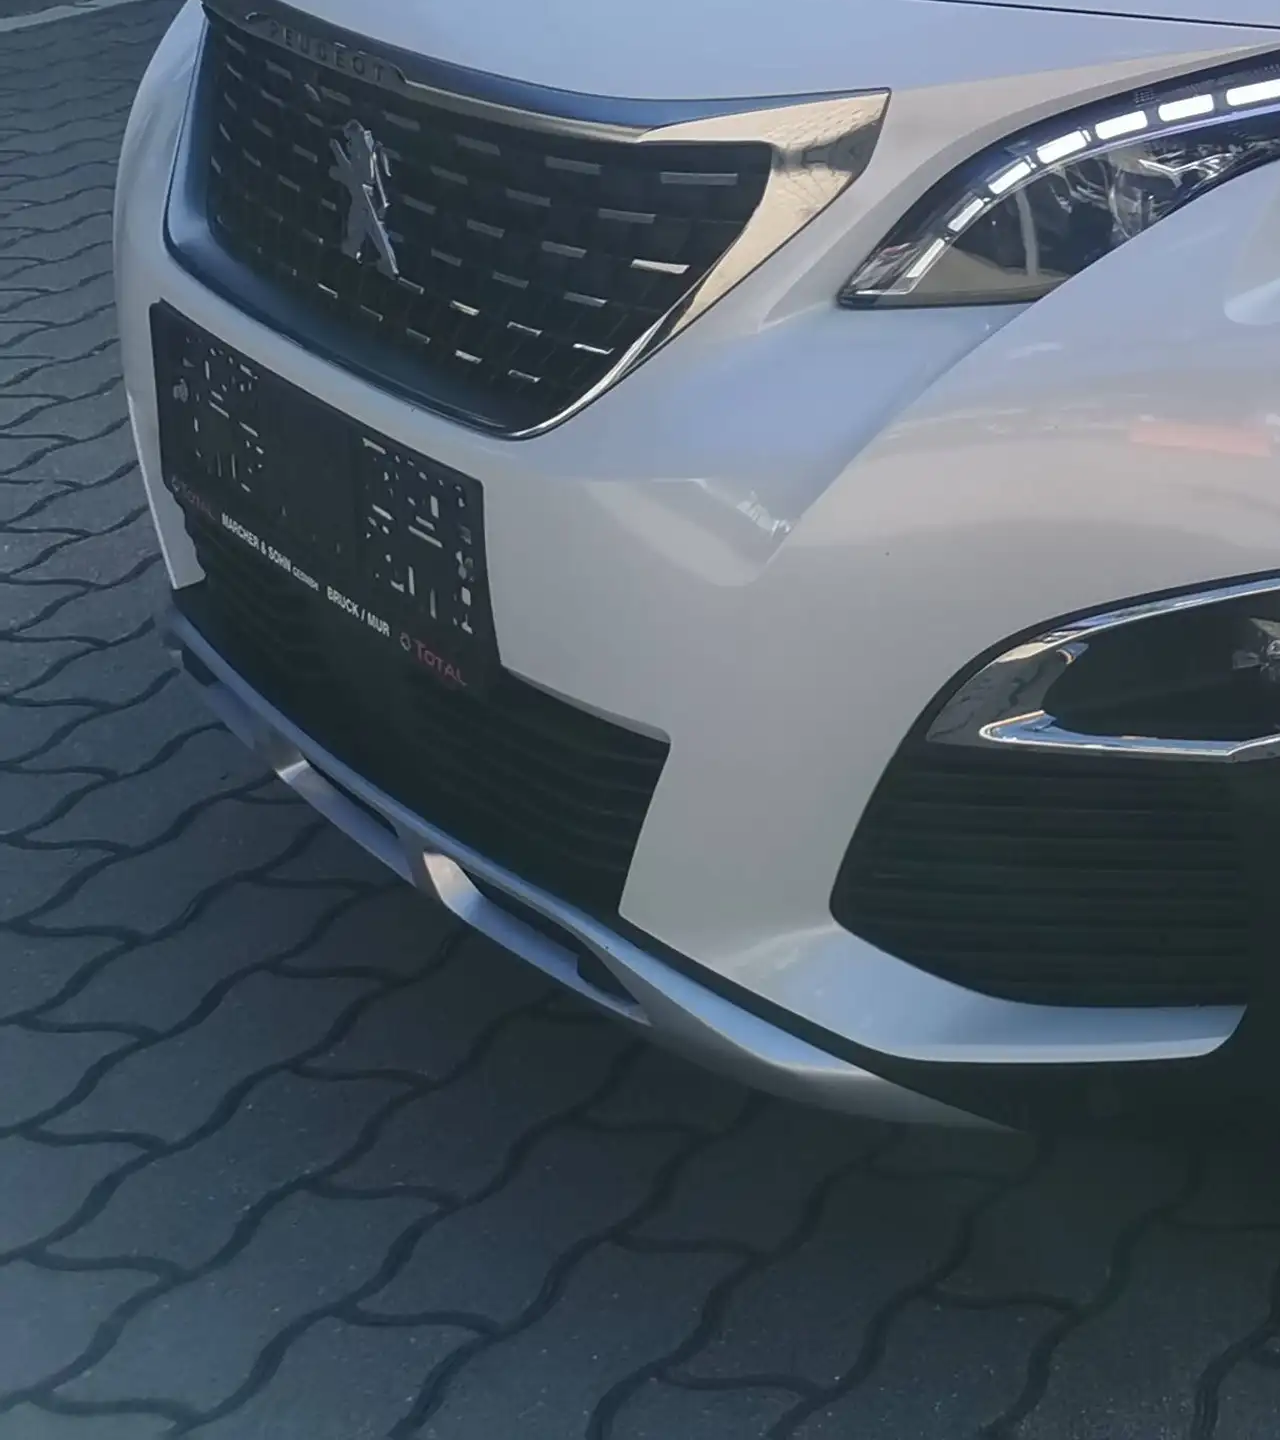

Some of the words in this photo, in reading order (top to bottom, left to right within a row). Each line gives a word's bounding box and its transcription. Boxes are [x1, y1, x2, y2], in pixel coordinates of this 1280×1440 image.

[269, 20, 384, 82] PEUGEOT
[221, 512, 260, 550] MARCHER
[267, 545, 292, 572] SOHN
[326, 585, 359, 618] BRUCK
[367, 611, 390, 637] MUR
[412, 638, 468, 686] TOTAL
